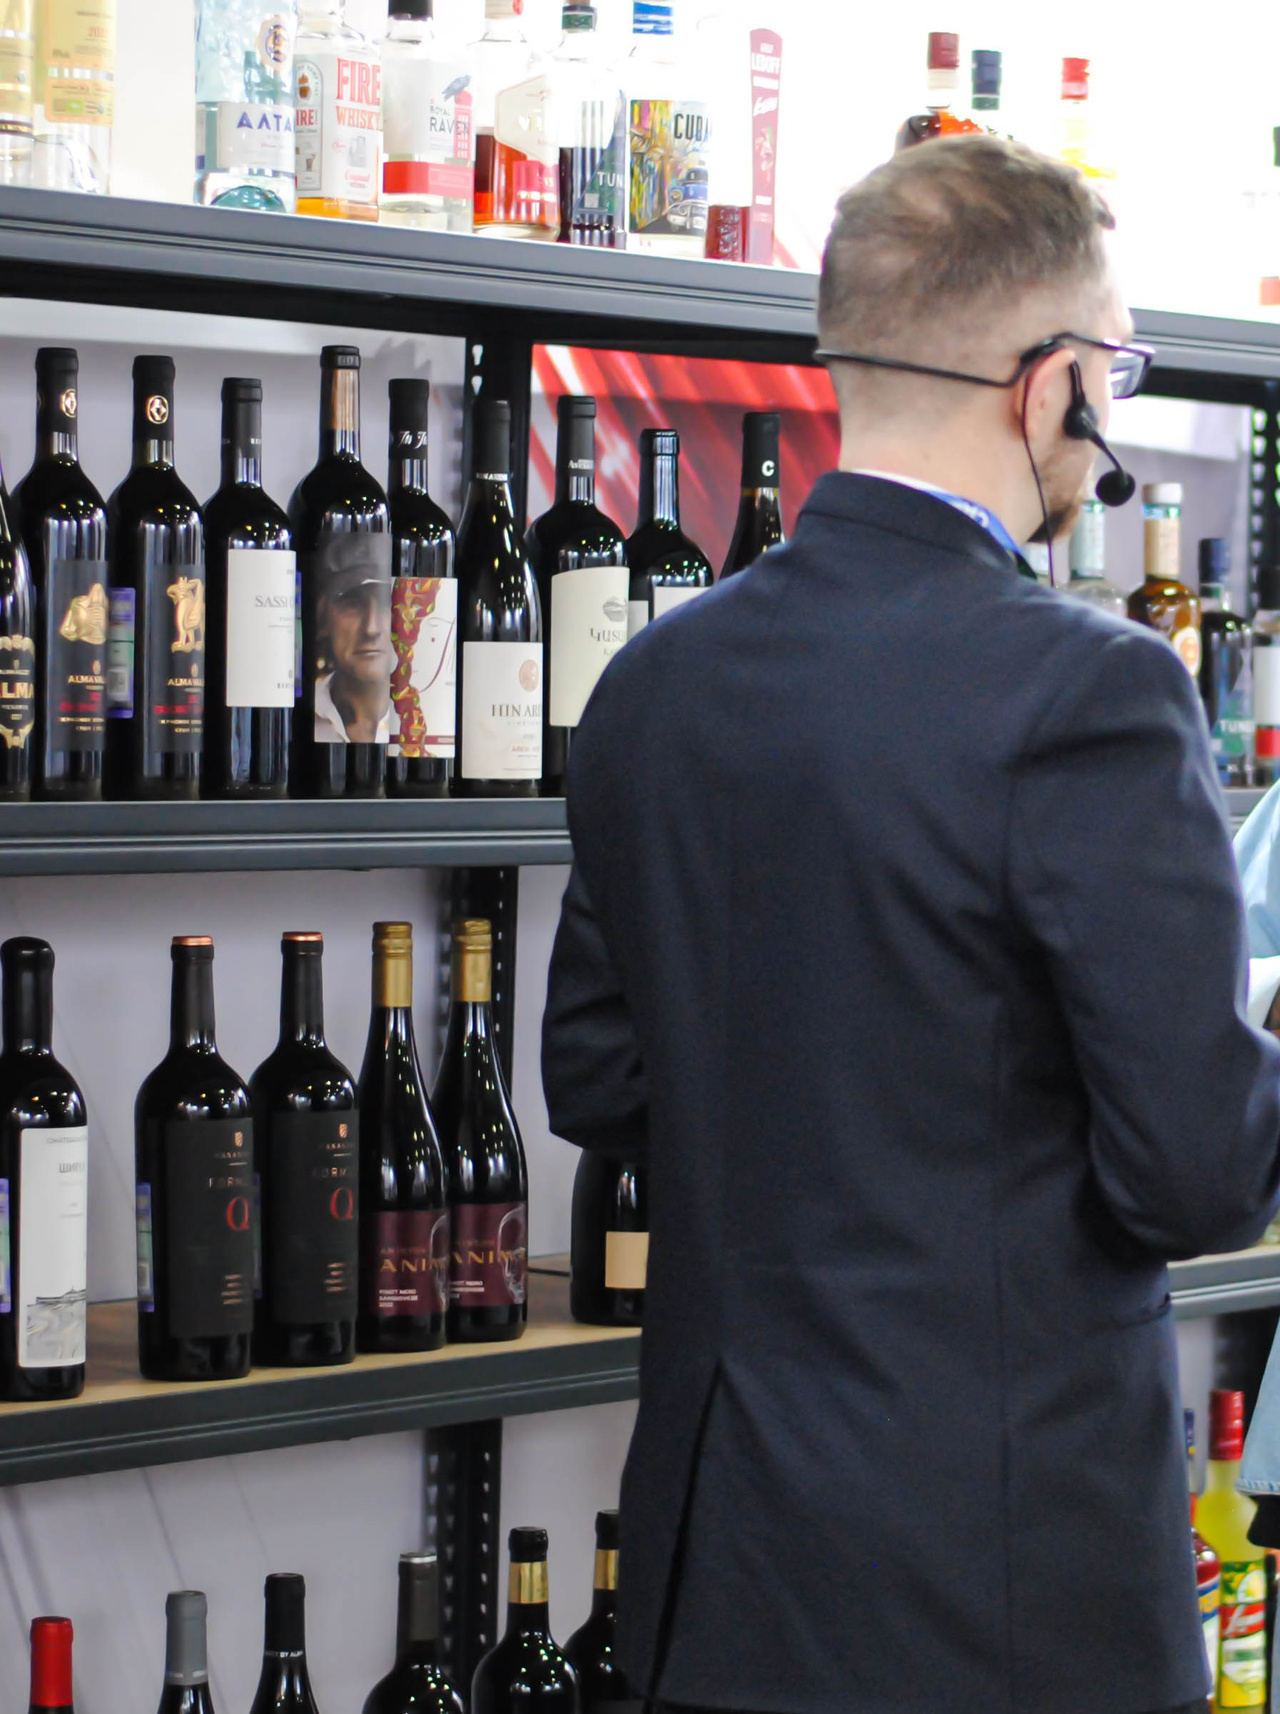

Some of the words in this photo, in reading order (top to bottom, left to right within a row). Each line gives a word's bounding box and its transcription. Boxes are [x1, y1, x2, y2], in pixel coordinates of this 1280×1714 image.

[336, 57, 381, 106] FIRE
[236, 111, 295, 132] АЛТА
[296, 109, 315, 126] IRE
[429, 116, 471, 136] RAVEN
[762, 460, 775, 477] C
[0, 682, 34, 699] LMA
